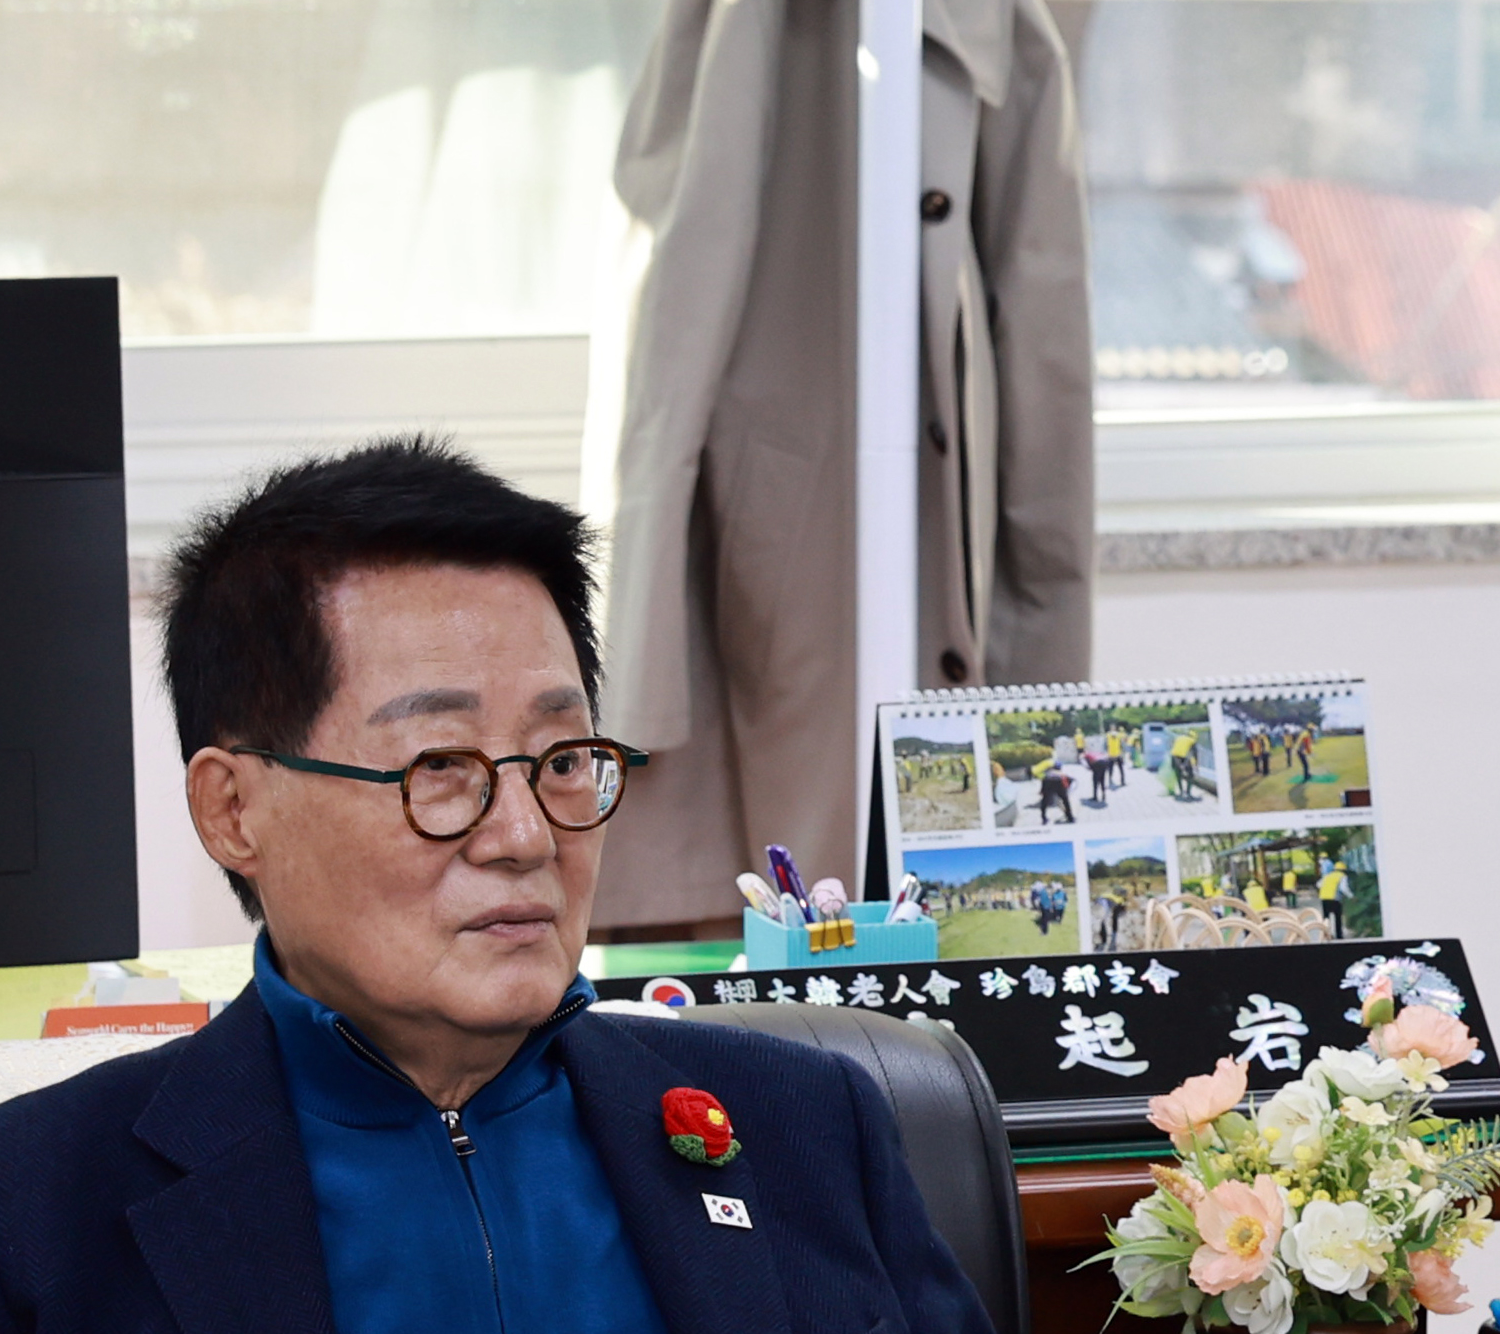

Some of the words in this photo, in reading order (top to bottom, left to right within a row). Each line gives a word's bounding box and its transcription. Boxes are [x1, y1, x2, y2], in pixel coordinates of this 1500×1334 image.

[978, 958, 1180, 1001] 珍島郡支會
